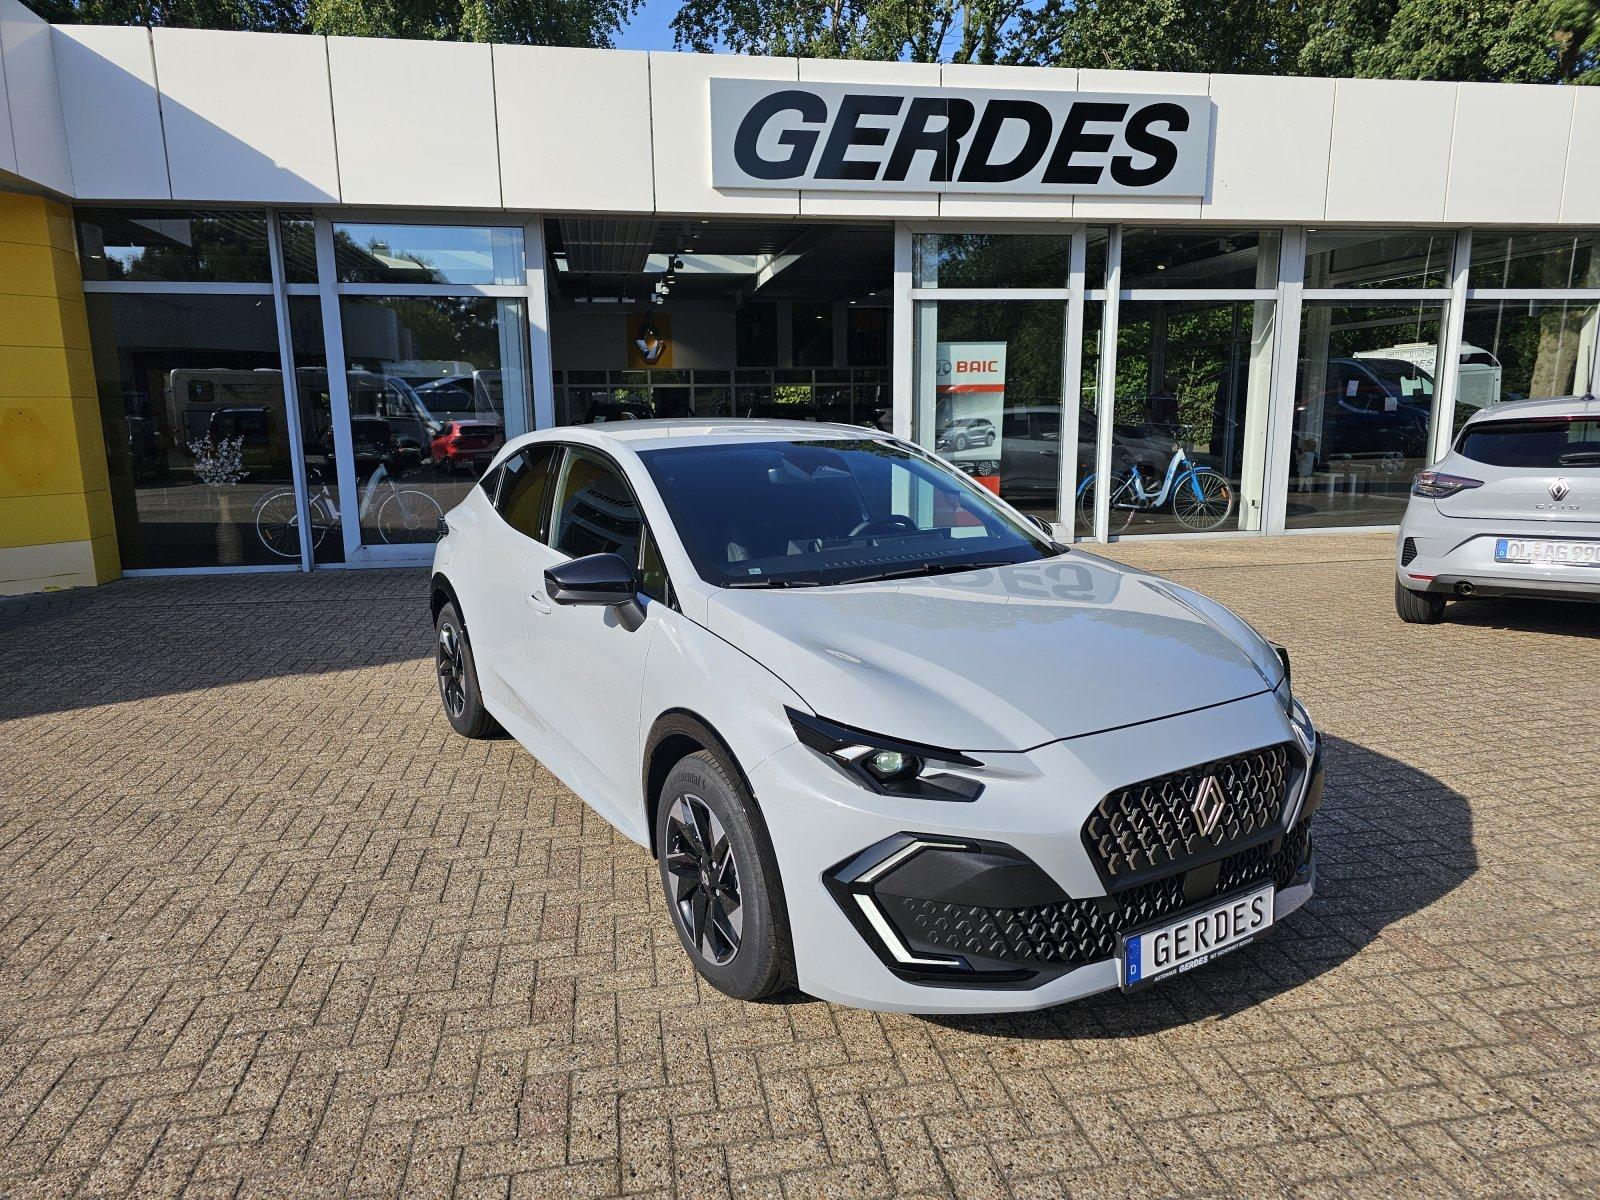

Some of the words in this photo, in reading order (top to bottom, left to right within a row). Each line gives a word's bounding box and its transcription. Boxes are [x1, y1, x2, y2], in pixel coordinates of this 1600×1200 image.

[733, 89, 1190, 187] GERDES
[956, 360, 998, 373] BAIC
[1535, 503, 1580, 511] CLIO
[1509, 543, 1529, 558] OL
[1543, 544, 1568, 560] AG
[1153, 896, 1263, 968] GERDES
[1130, 964, 1137, 975] D
[1178, 955, 1208, 973] GERDES
